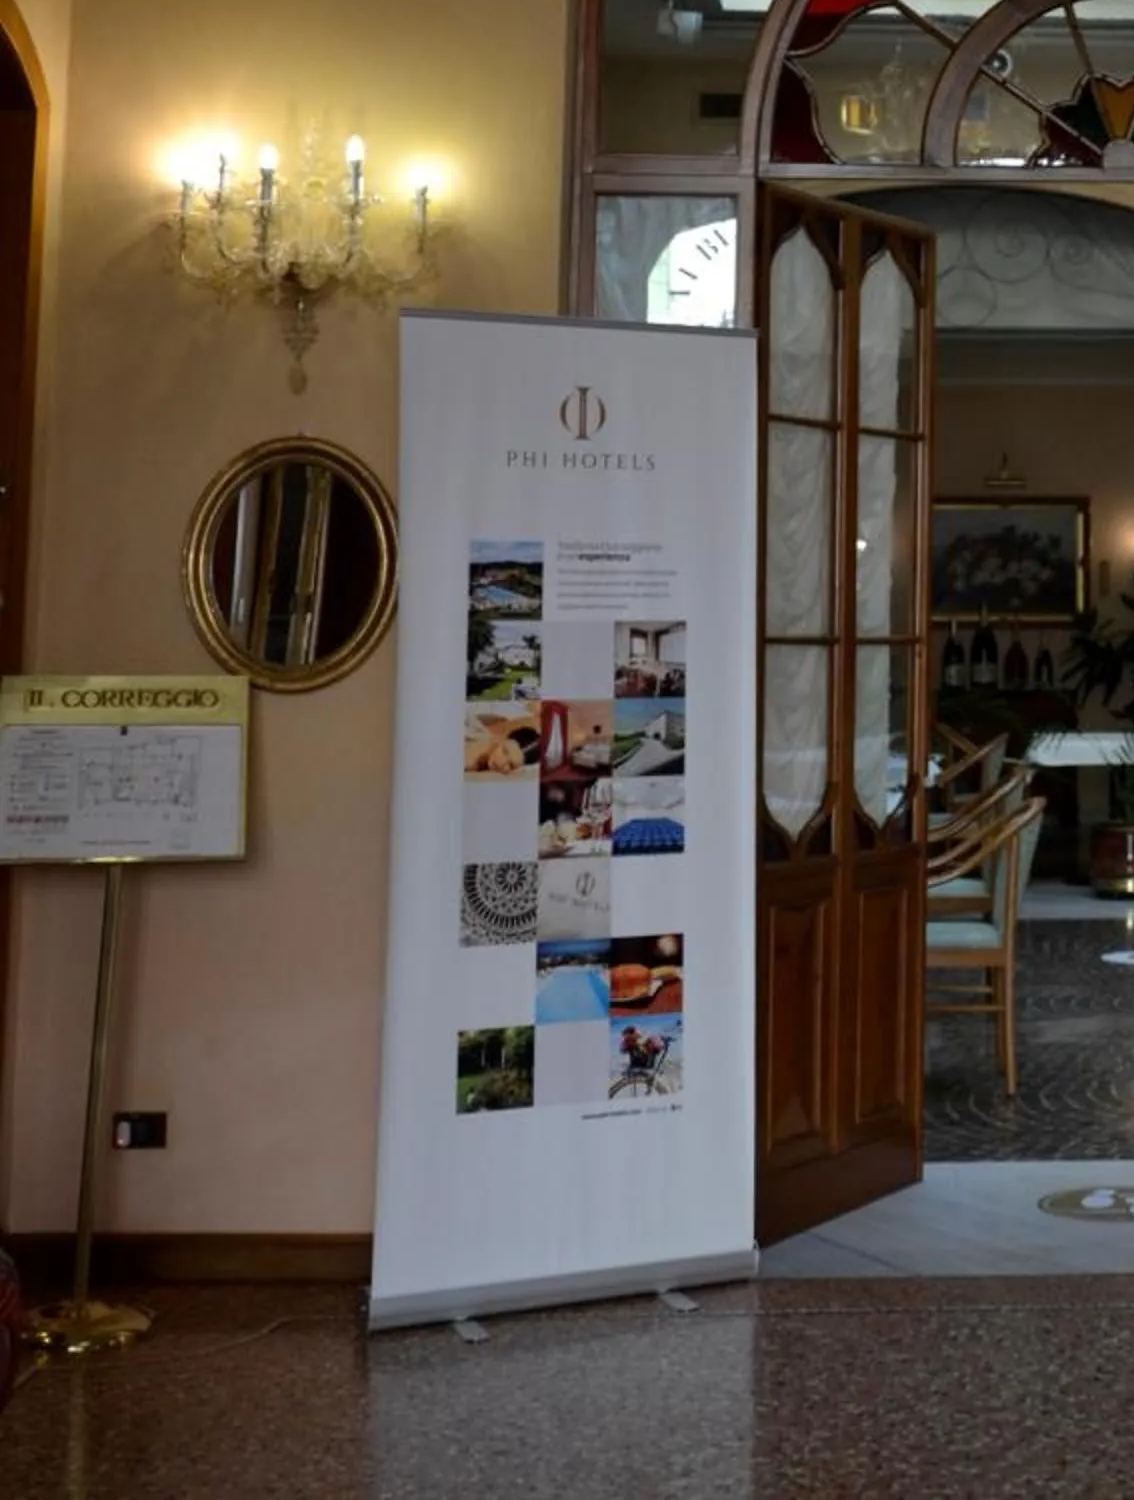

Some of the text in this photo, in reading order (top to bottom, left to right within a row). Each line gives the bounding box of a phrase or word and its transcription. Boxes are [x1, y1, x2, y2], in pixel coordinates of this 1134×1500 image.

[506, 449, 656, 471] PHI HOTELS
[61, 688, 220, 709] CORREGGIO
